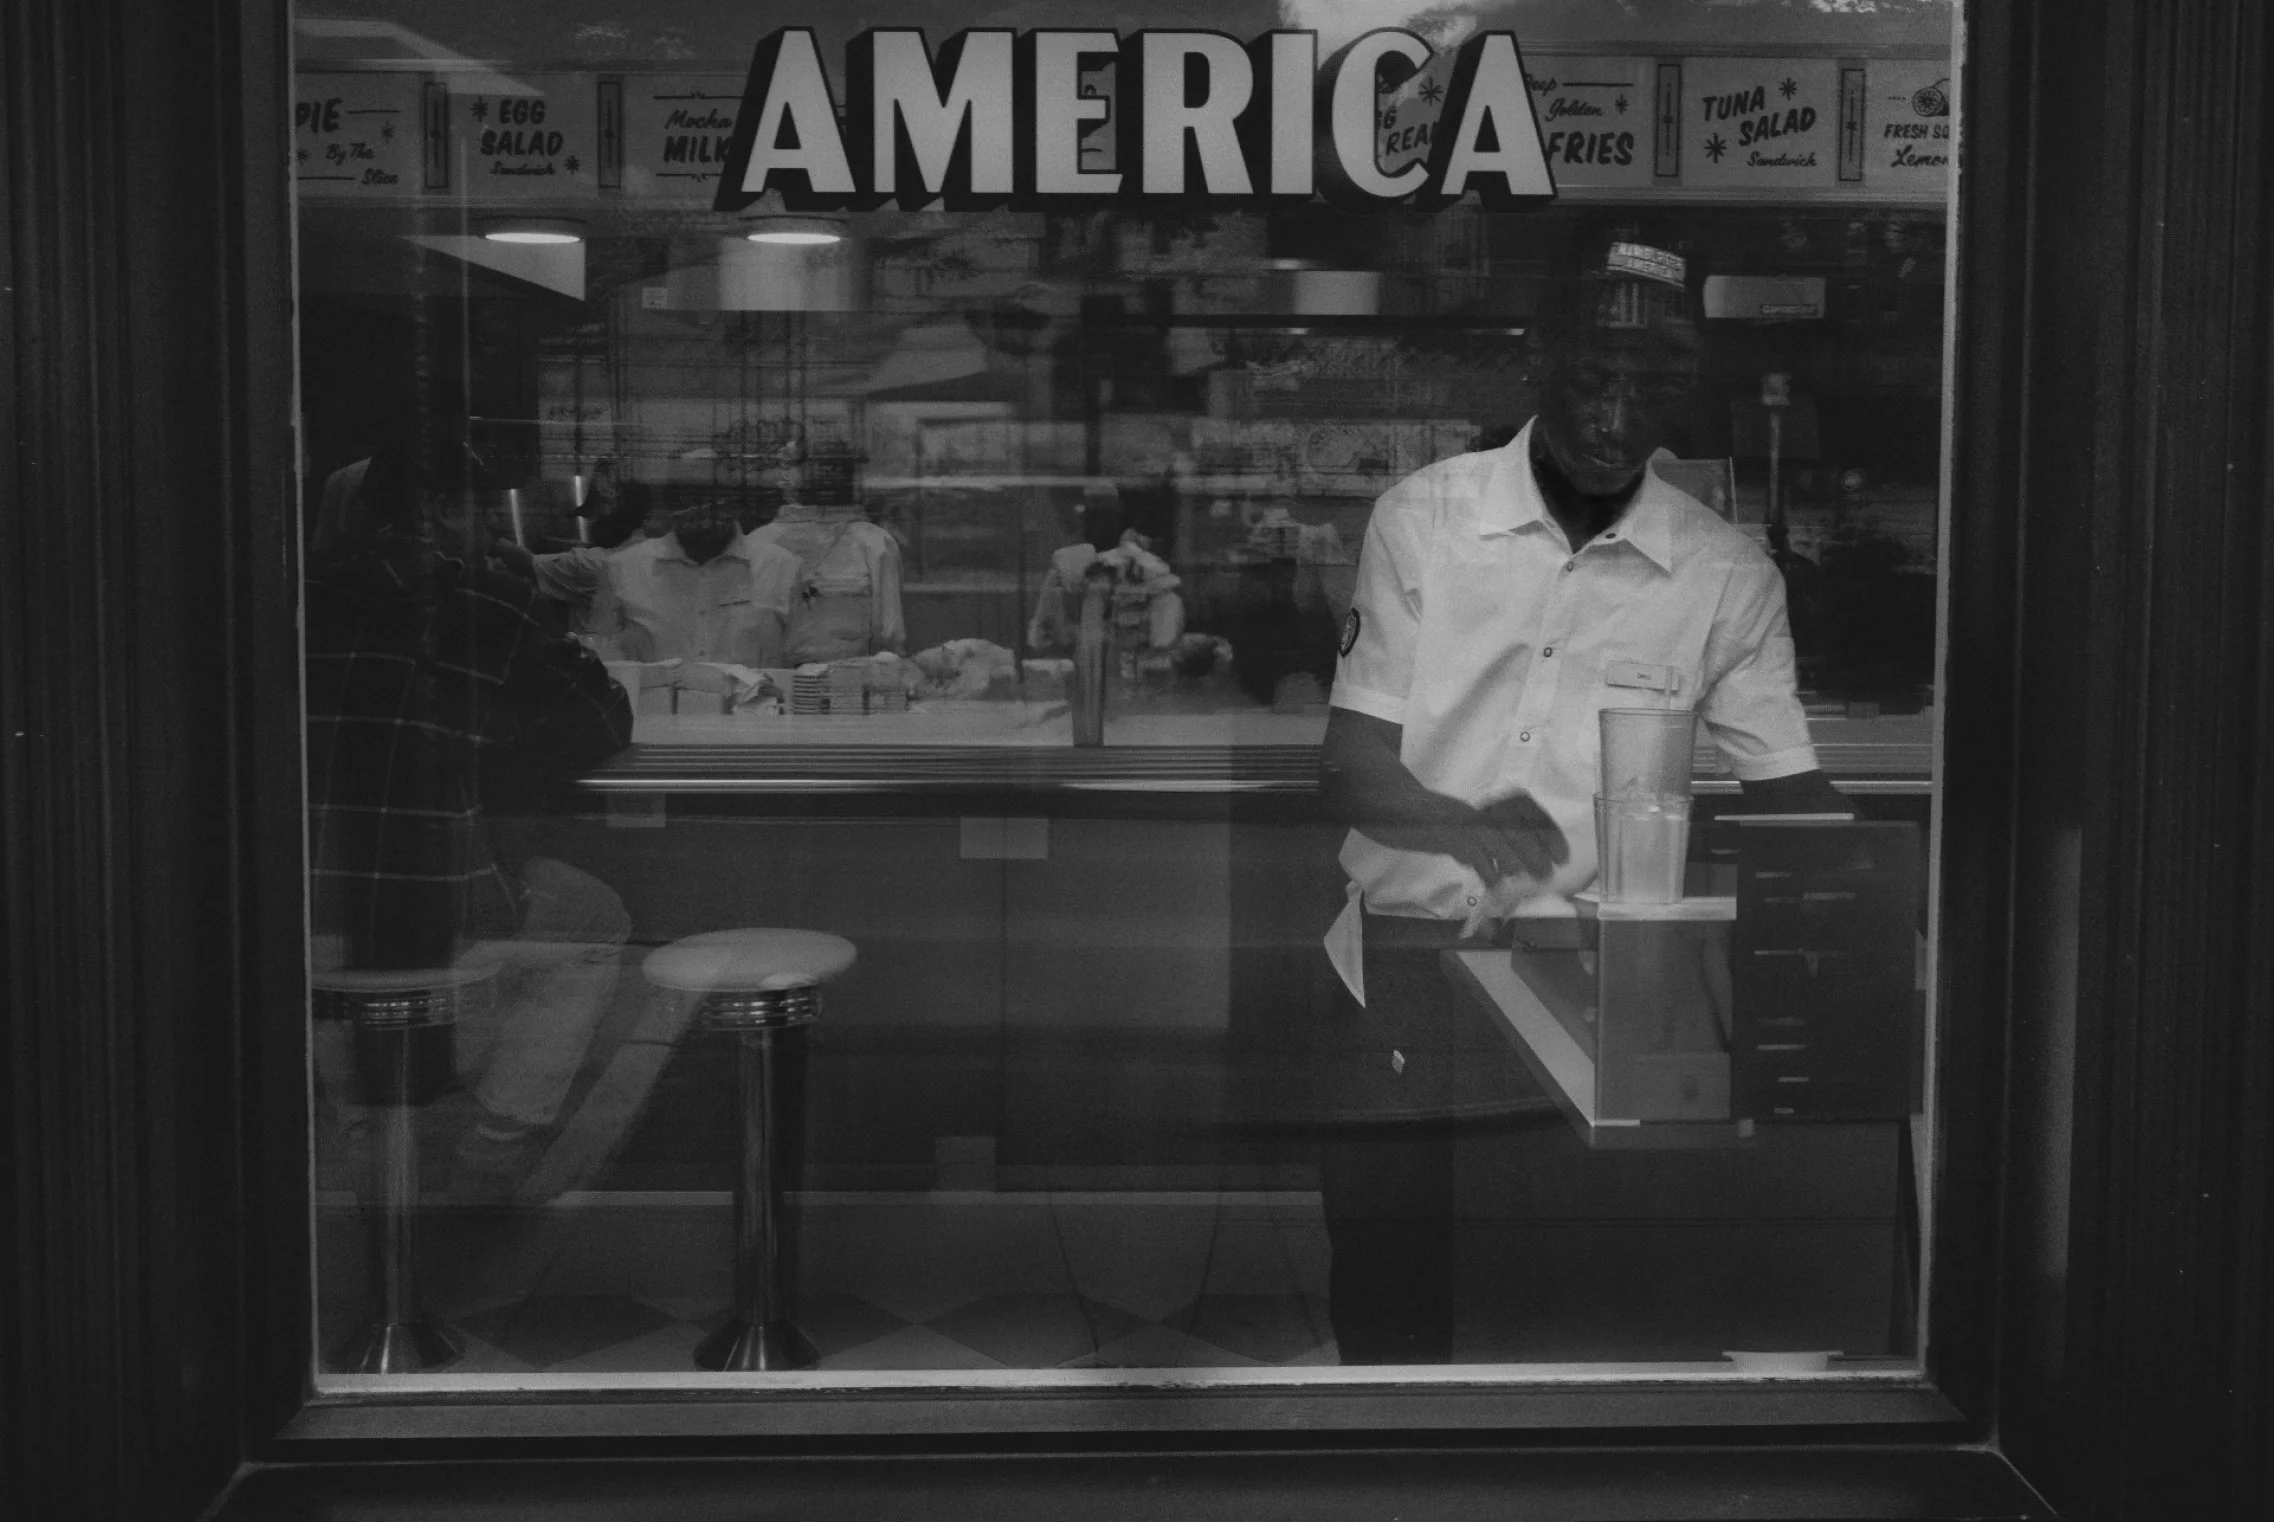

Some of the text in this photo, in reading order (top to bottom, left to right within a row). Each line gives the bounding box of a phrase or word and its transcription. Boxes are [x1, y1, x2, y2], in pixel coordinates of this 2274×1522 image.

[295, 98, 342, 133] PIE
[499, 98, 546, 125] EGG
[738, 28, 1558, 198] AMERICA
[1545, 97, 1603, 122] Golden
[1701, 85, 1765, 122] TUNA
[664, 108, 733, 130] Mocha
[1738, 106, 1816, 146] SALAD
[1883, 123, 1929, 139] FRESH
[325, 142, 374, 166] By The
[481, 129, 564, 156] SALAD
[1547, 130, 1634, 166] FRIES
[489, 160, 556, 175] Sandwich
[1747, 150, 1818, 167] Sandwich
[362, 167, 399, 185] Slice
